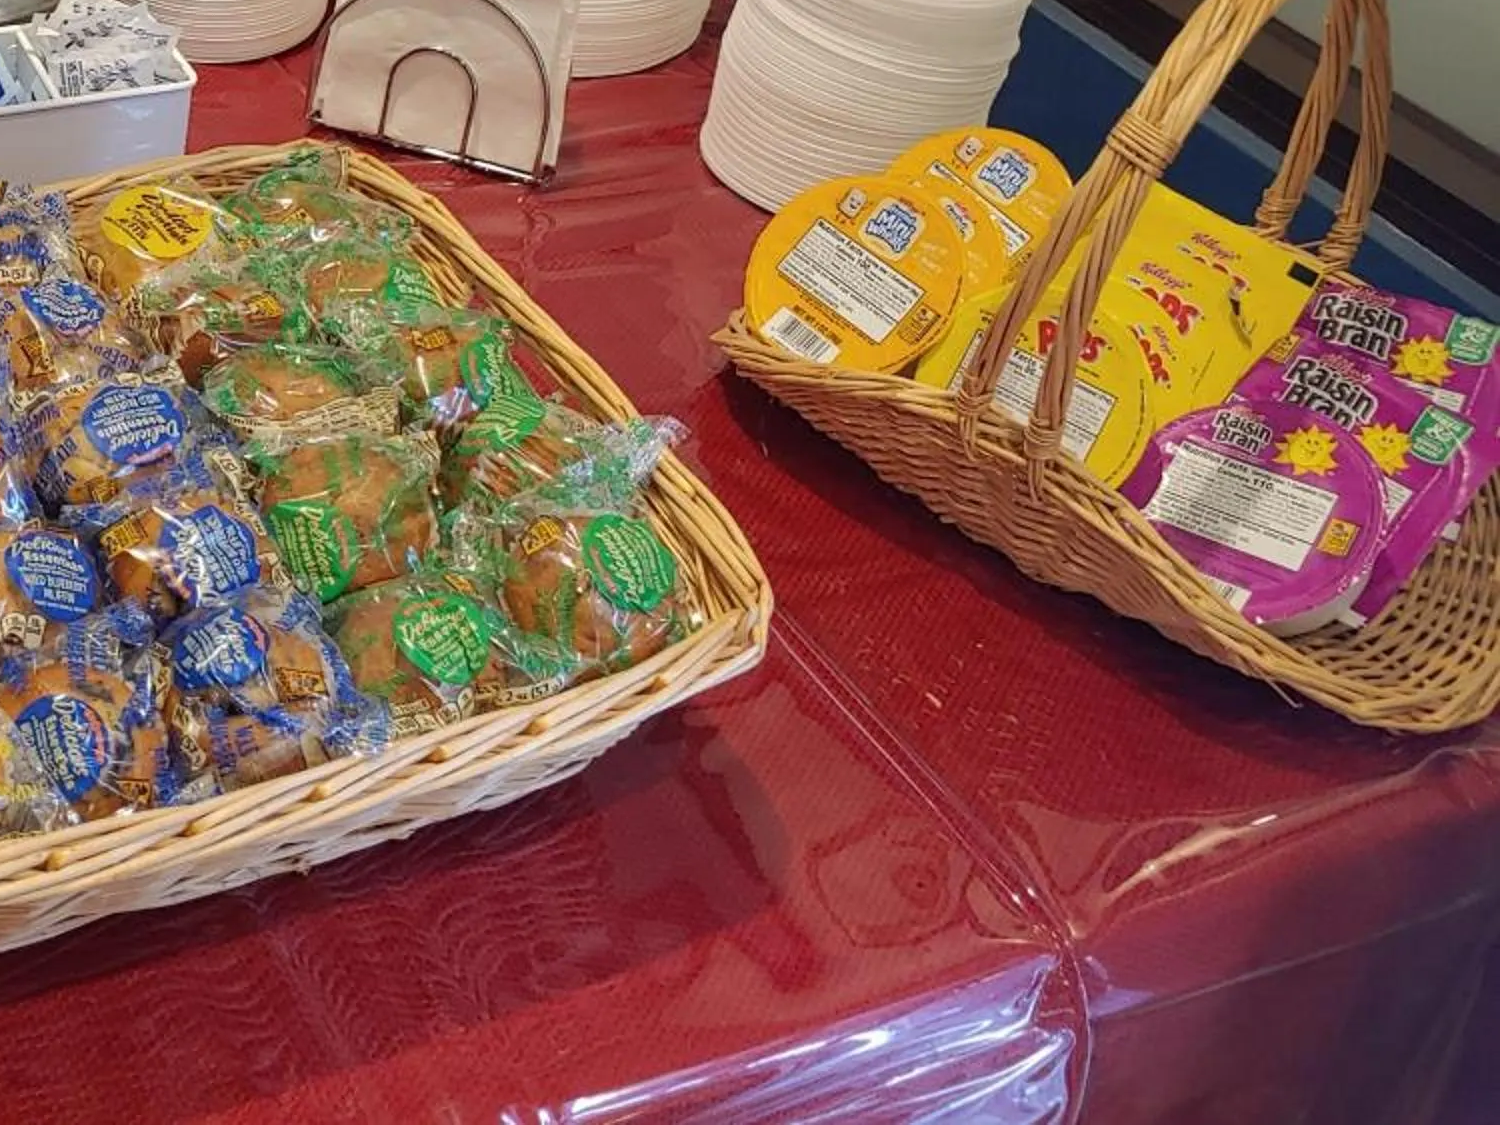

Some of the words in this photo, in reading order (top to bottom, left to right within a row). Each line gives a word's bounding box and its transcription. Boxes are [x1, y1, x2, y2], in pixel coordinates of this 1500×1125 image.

[875, 210, 910, 238] Mini
[1313, 294, 1406, 340] Raisin
[1318, 319, 1390, 360] Bran
[1283, 384, 1355, 430] Bran
[1285, 357, 1377, 422] Raisin
[109, 419, 180, 450] Delicious
[1214, 428, 1261, 454] Bran
[1215, 411, 1271, 442] Raisin
